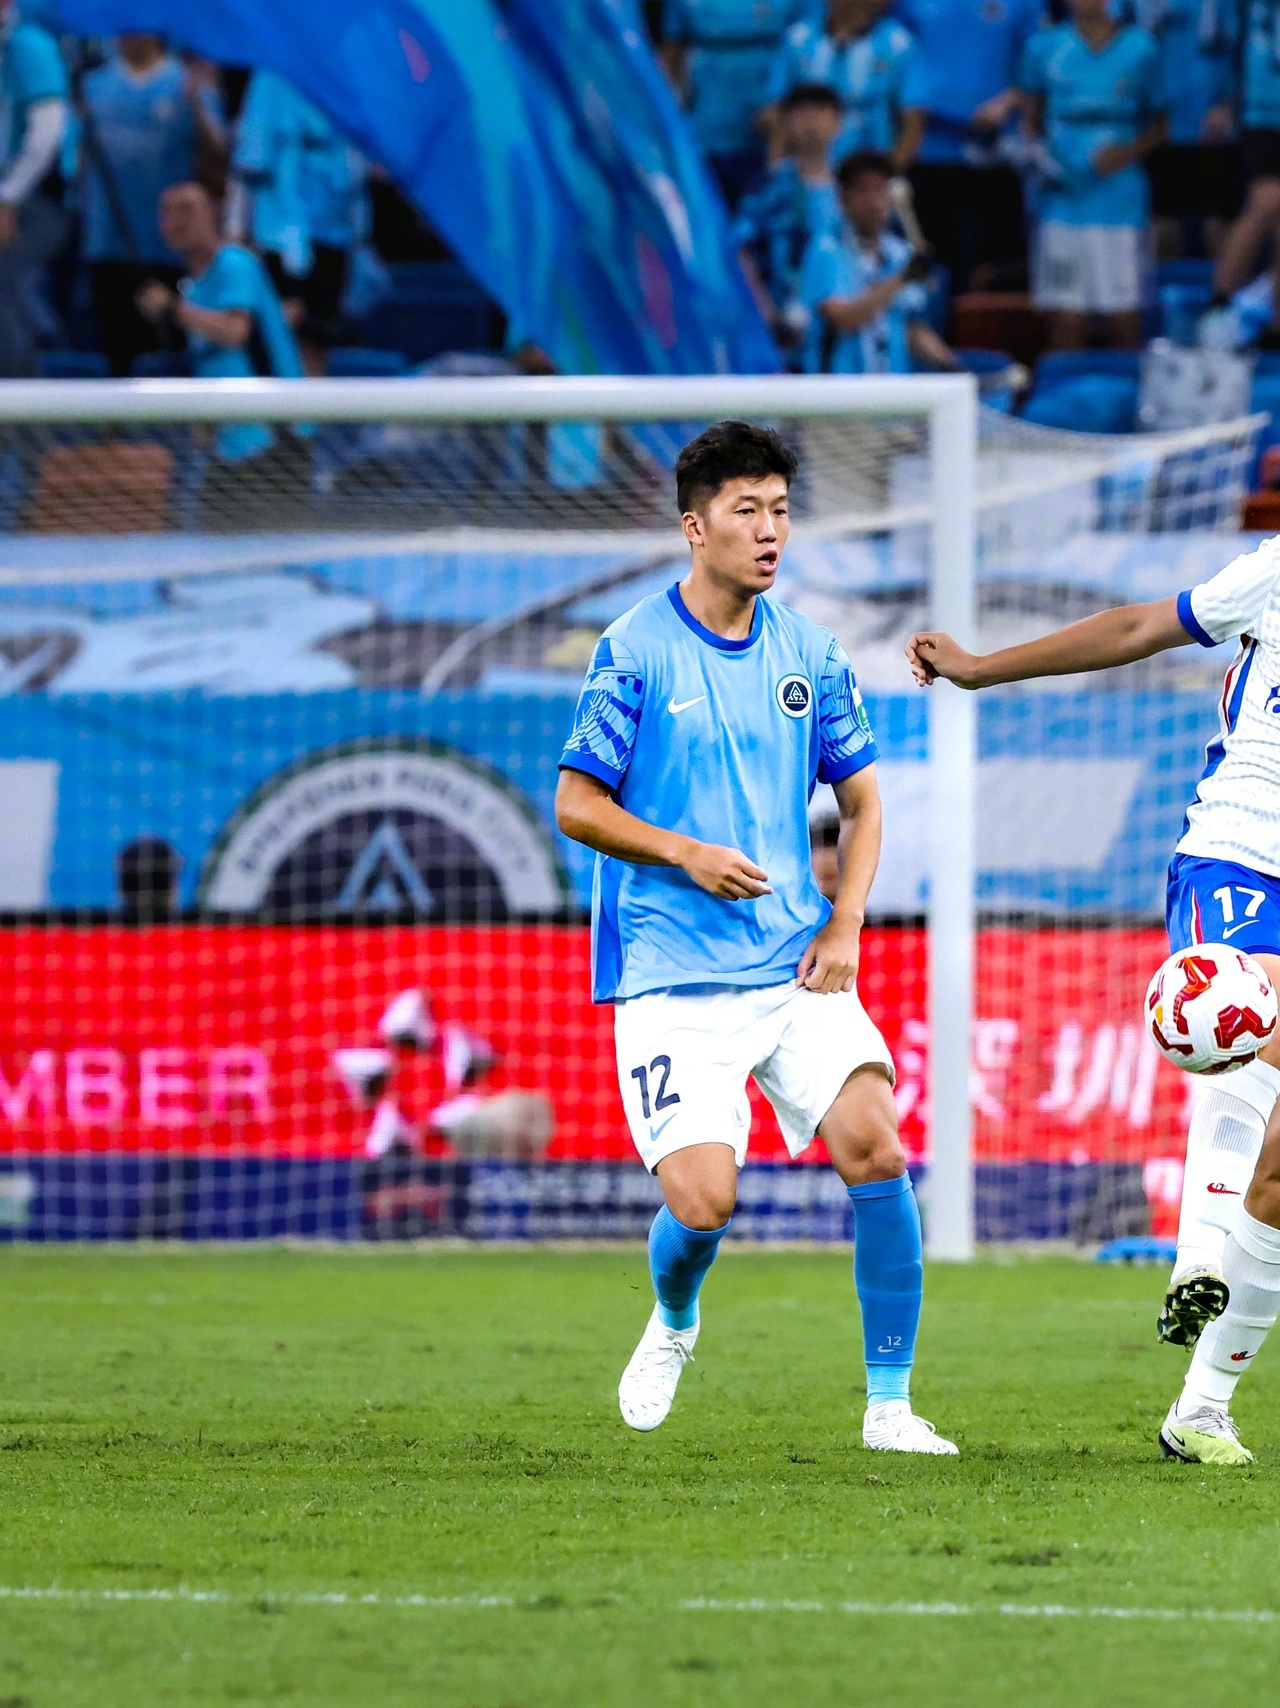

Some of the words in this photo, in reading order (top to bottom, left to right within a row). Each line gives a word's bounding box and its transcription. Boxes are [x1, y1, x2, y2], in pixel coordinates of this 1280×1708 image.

[1213, 886, 1266, 923] 17
[631, 1054, 681, 1119] 12
[886, 1335, 902, 1347] 12
